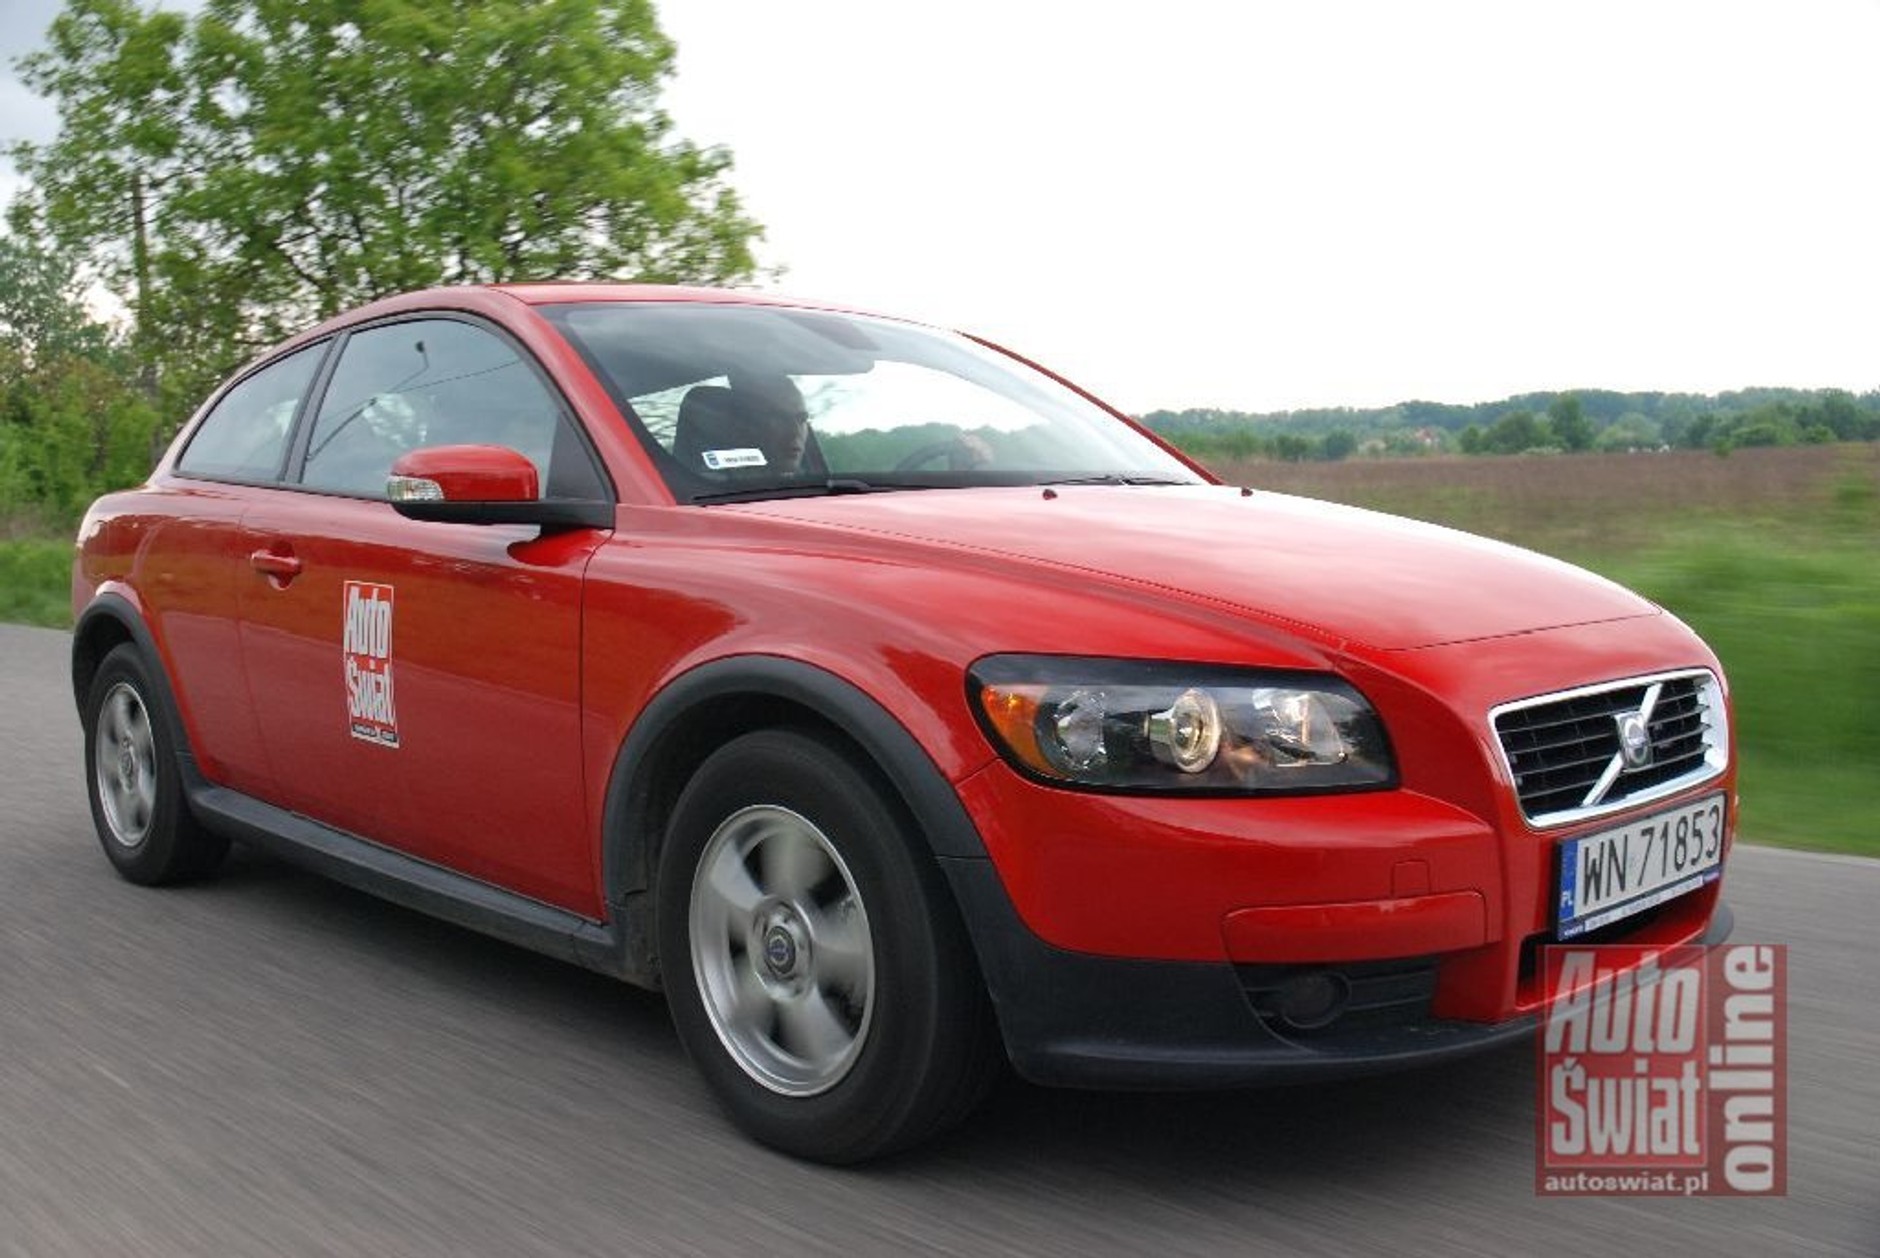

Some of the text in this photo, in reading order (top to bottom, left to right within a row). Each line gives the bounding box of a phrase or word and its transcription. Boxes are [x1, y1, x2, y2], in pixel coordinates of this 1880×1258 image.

[344, 586, 391, 659] Auto
[1583, 804, 1720, 906] WN 71853
